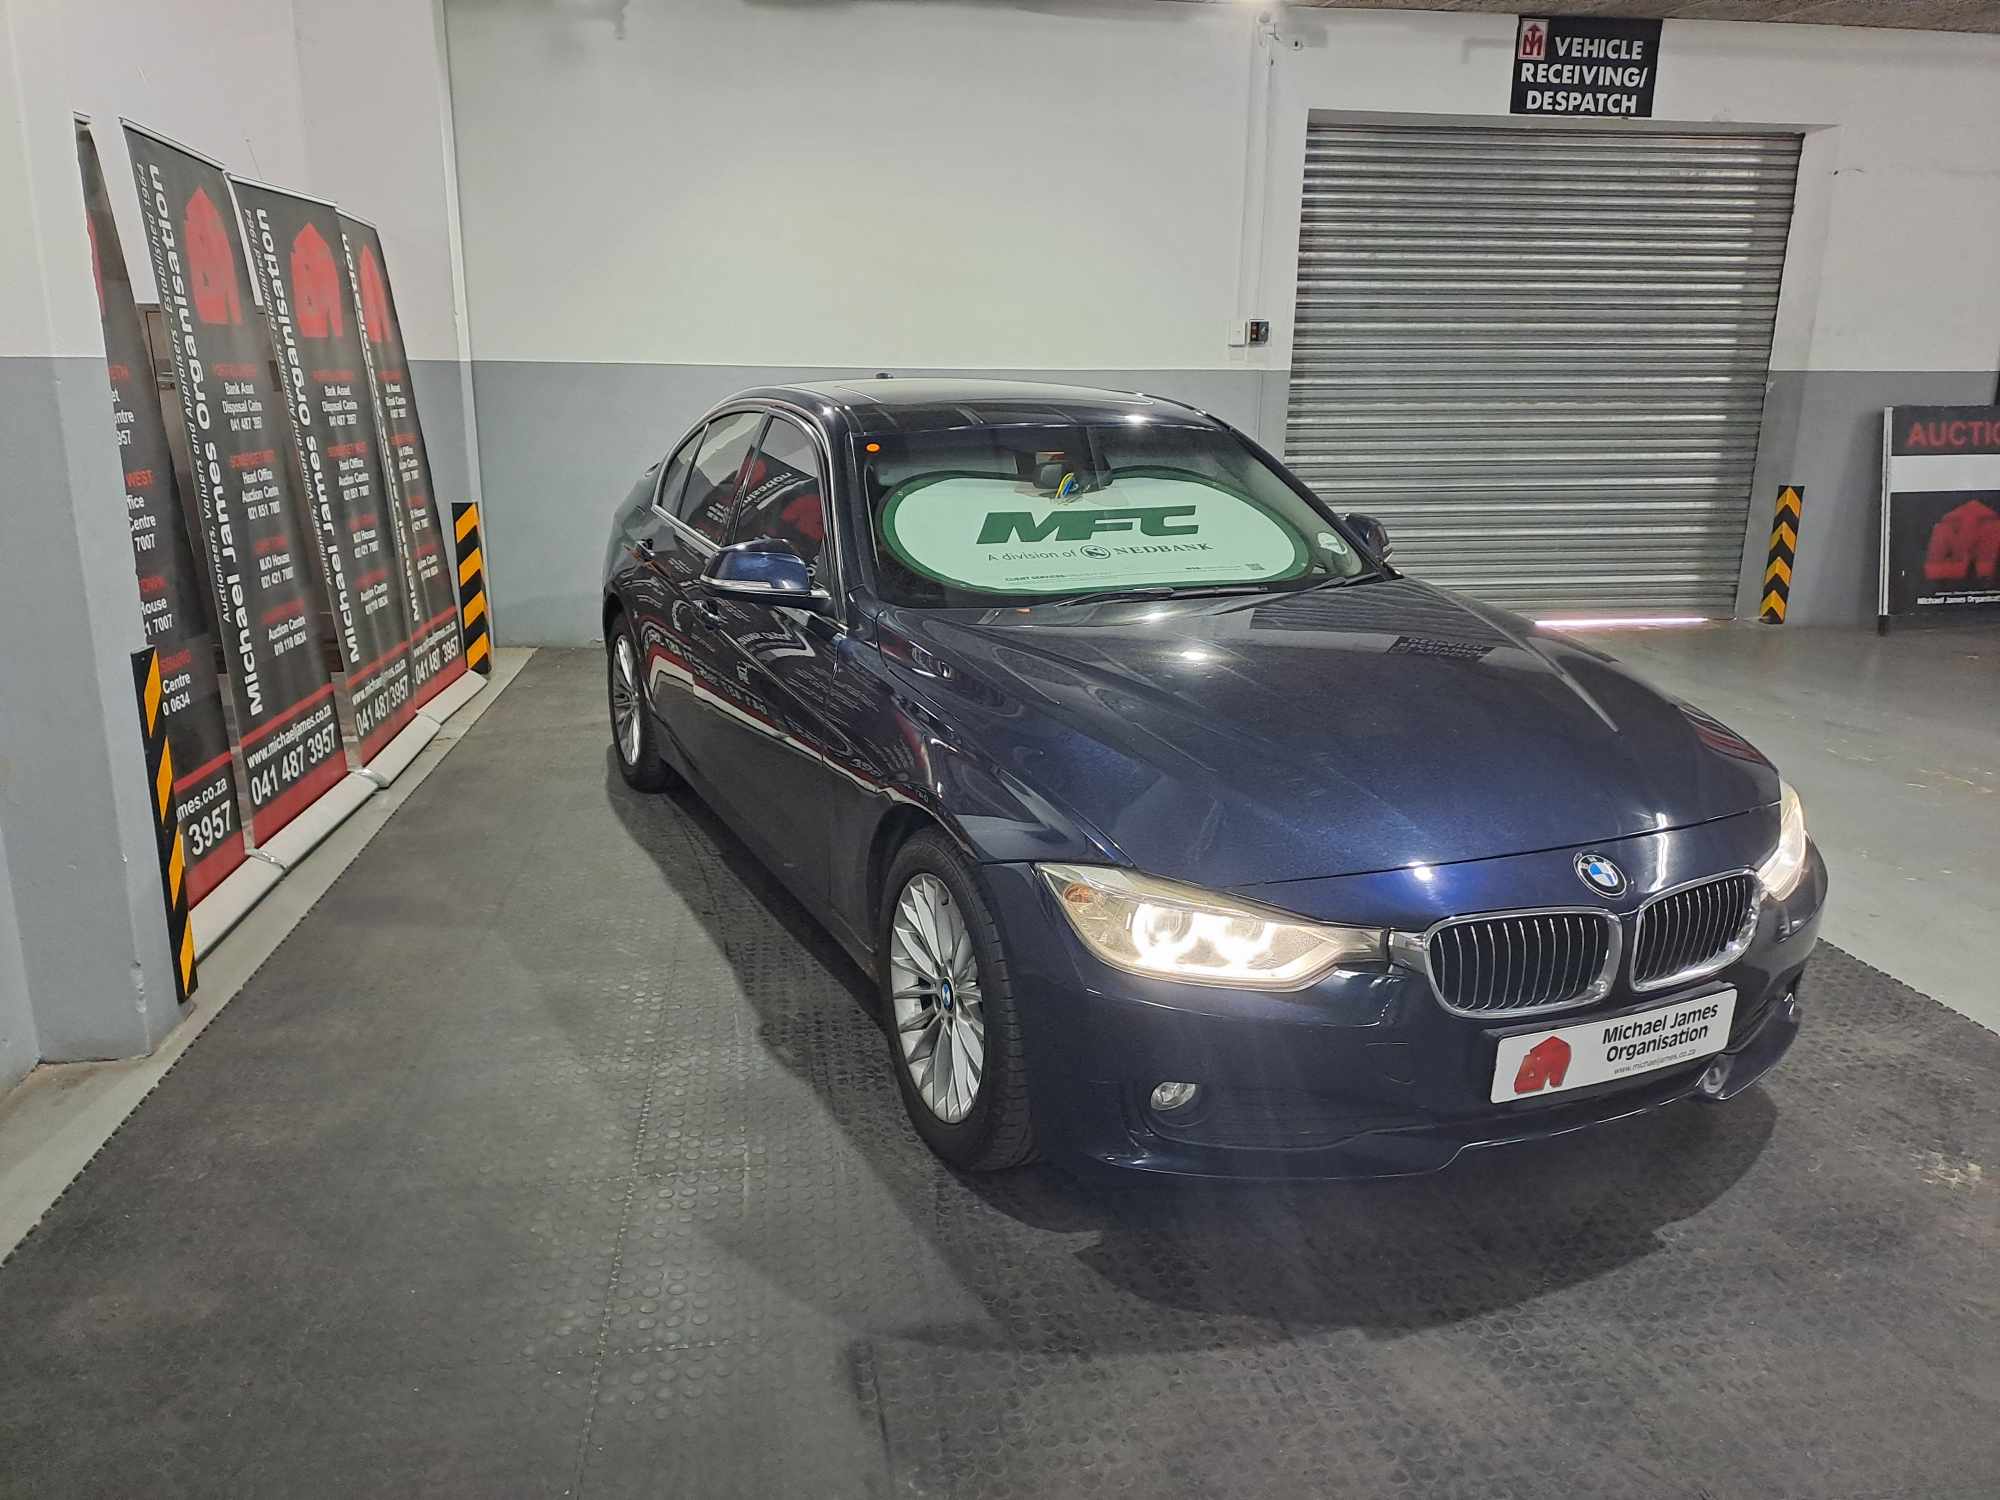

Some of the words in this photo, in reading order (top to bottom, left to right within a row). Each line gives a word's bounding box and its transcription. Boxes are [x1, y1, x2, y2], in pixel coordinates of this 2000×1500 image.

[1554, 37, 1644, 60] VEHICLE
[1521, 63, 1648, 88] RECEIVING/
[1526, 90, 1637, 114] DESPATCH
[136, 163, 152, 204] 1964
[145, 212, 172, 314] Established
[149, 164, 210, 430] Organisation
[256, 208, 311, 426] Organisation
[170, 329, 193, 417] Appraisers
[187, 422, 200, 455] and
[194, 459, 212, 519] Valuers
[205, 442, 237, 563] James
[306, 436, 335, 536] James
[134, 533, 155, 552] 7007
[976, 505, 1199, 544] MFC
[209, 526, 231, 623] Auctioneers,
[988, 552, 999, 562] A
[1002, 550, 1060, 561] division
[1063, 549, 1076, 559] of
[1113, 543, 1217, 555] NEDBANK
[152, 613, 172, 633] 7007
[327, 545, 360, 663] Michael
[227, 574, 263, 716] Michael
[415, 658, 430, 685] 041
[442, 635, 459, 663] 3957
[163, 673, 191, 694] Centre
[170, 691, 190, 712] 0634
[356, 704, 374, 736] 041
[375, 692, 390, 720] 487
[390, 675, 409, 707] 3957
[251, 764, 279, 805] 041
[281, 745, 304, 783] 487
[307, 723, 335, 764] 3957
[188, 800, 232, 856] 3957
[1602, 1015, 1668, 1045] Michael
[1670, 1003, 1719, 1029] James
[1606, 1024, 1709, 1063] Organisation
